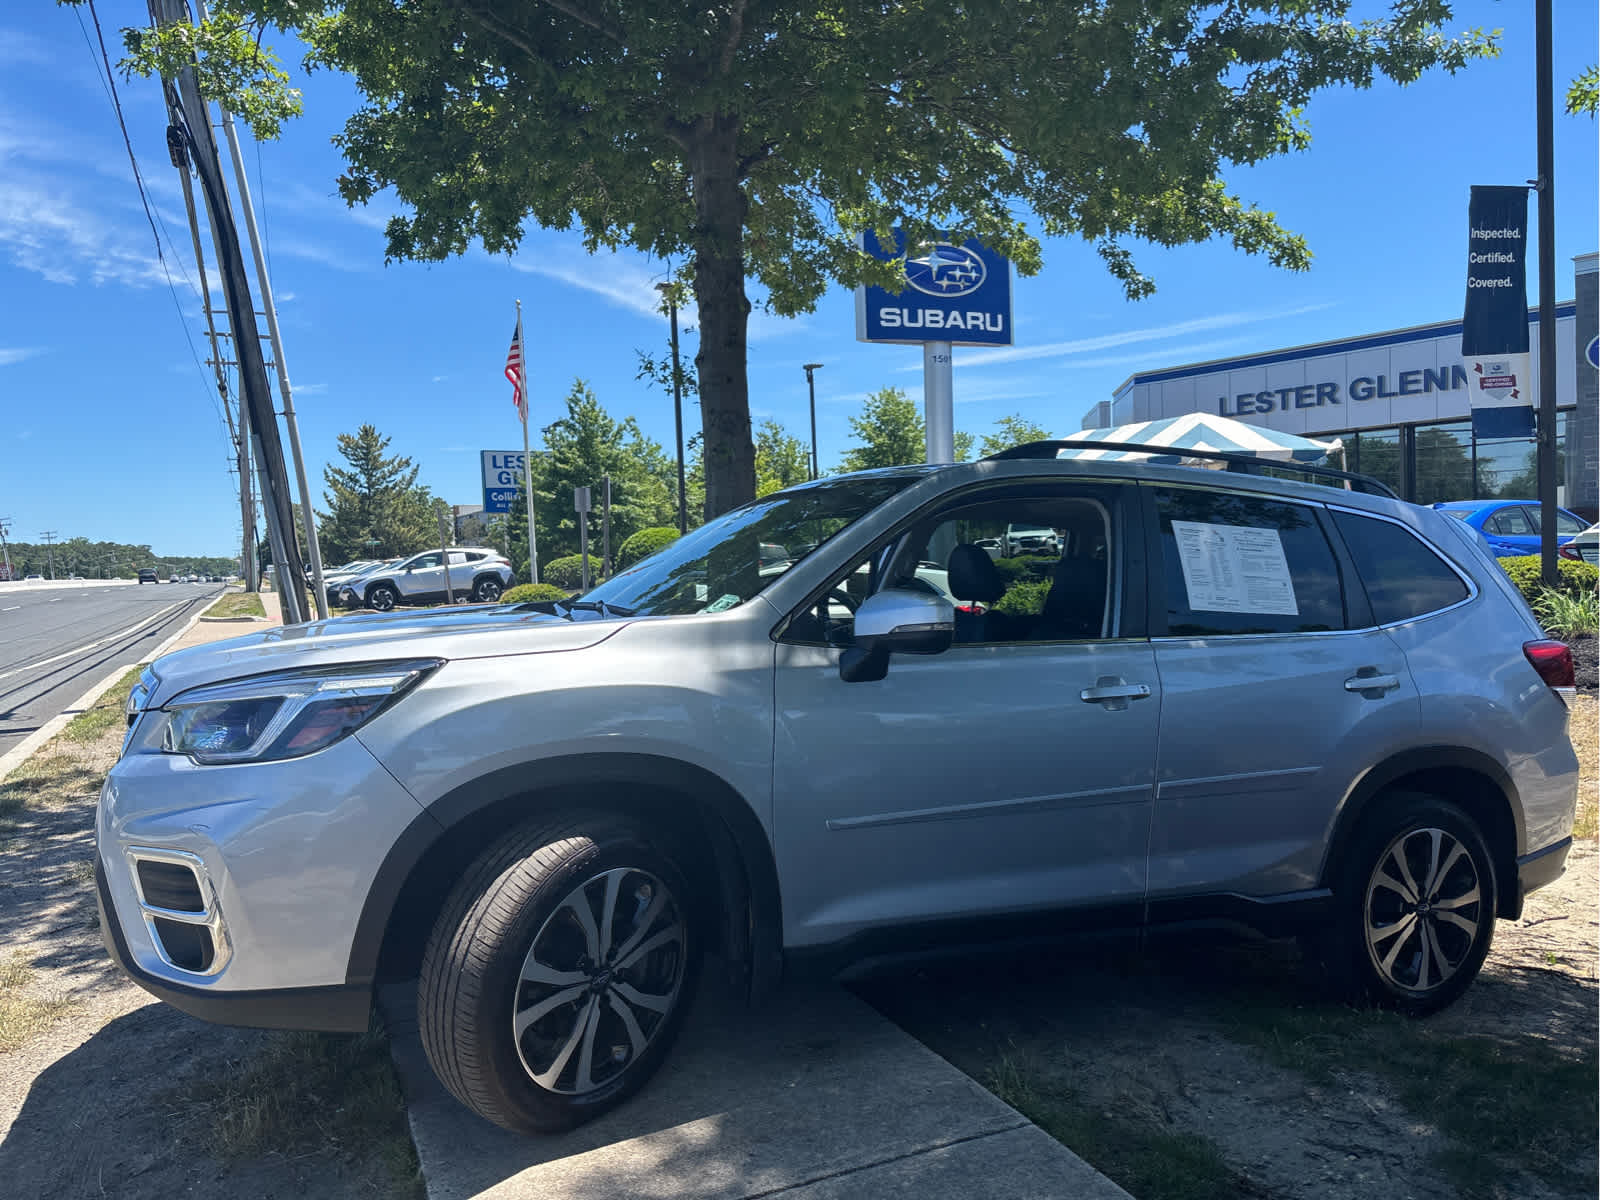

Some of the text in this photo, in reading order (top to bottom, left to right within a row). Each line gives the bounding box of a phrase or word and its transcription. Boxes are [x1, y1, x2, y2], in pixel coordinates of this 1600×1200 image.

[1471, 227, 1521, 240] Inspected.
[1469, 252, 1516, 263] Certified.
[1468, 276, 1513, 288] Covered.
[879, 307, 1003, 332] SUBARU
[1219, 365, 1468, 417] LESTER GLENN
[492, 455, 525, 469] LES
